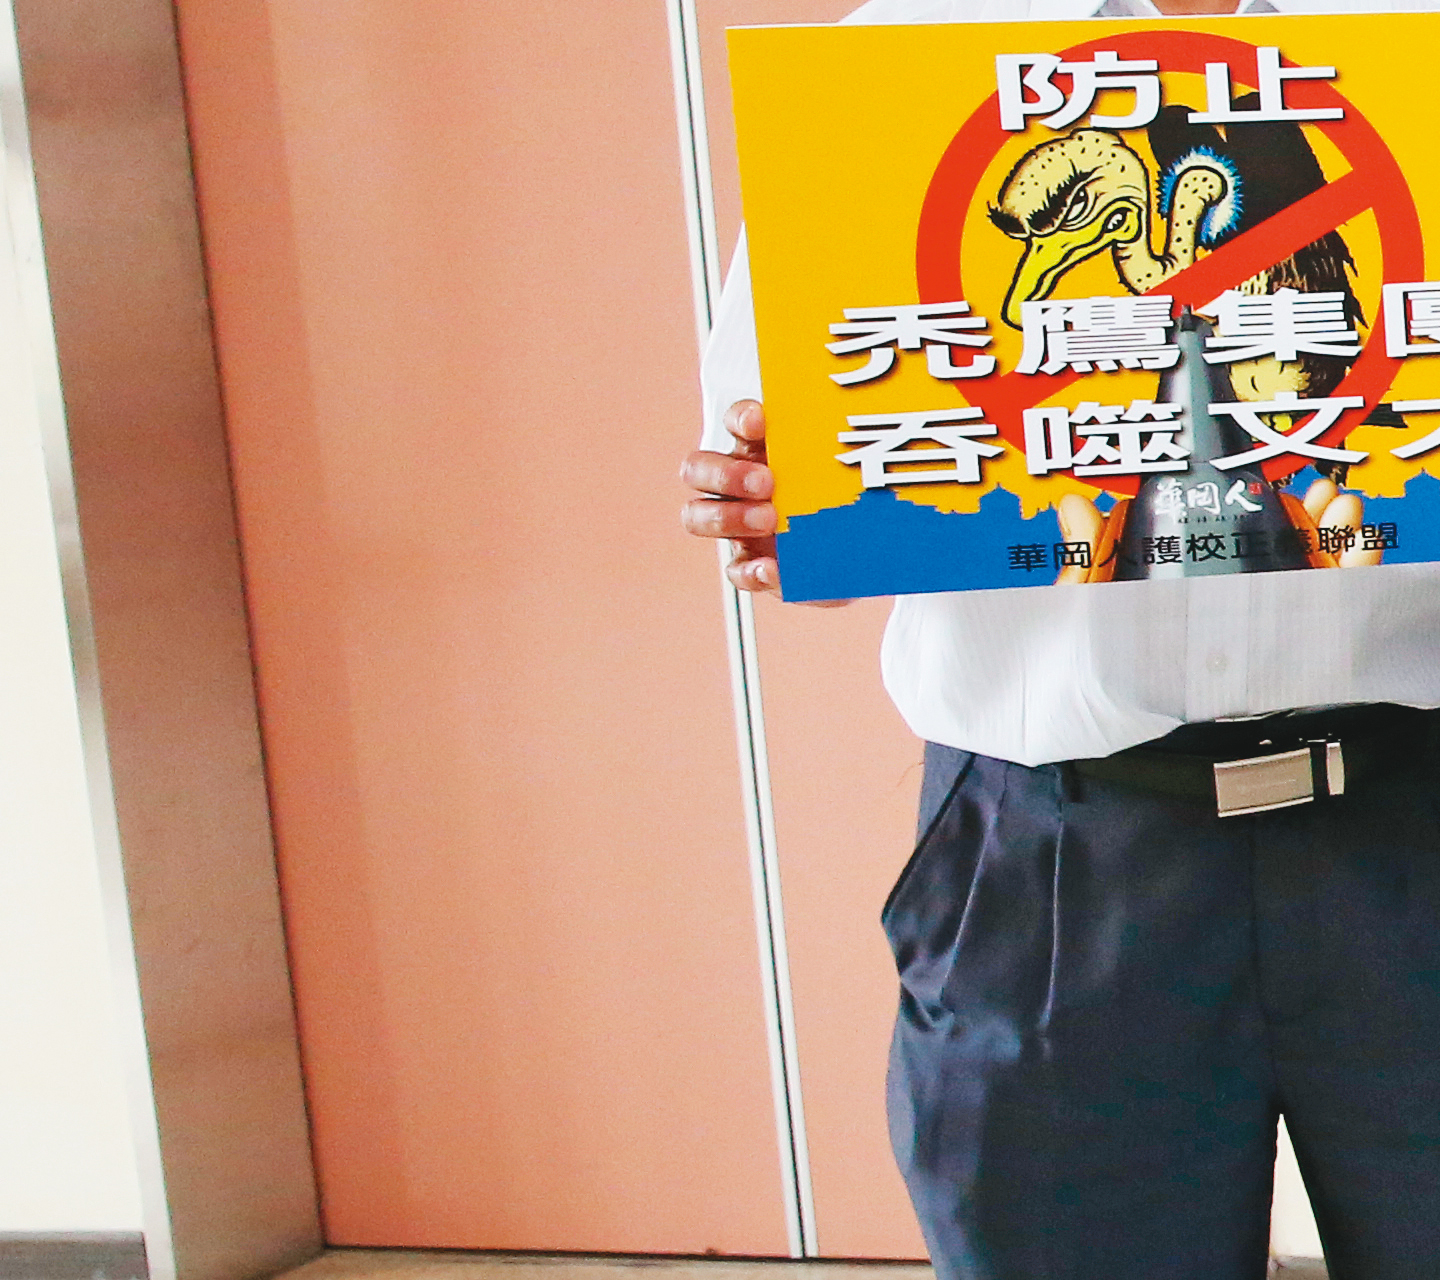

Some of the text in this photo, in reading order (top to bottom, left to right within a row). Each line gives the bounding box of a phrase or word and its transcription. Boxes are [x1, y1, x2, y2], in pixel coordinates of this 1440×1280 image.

[996, 46, 1344, 132] 防止
[1154, 477, 1263, 524] 華岡人
